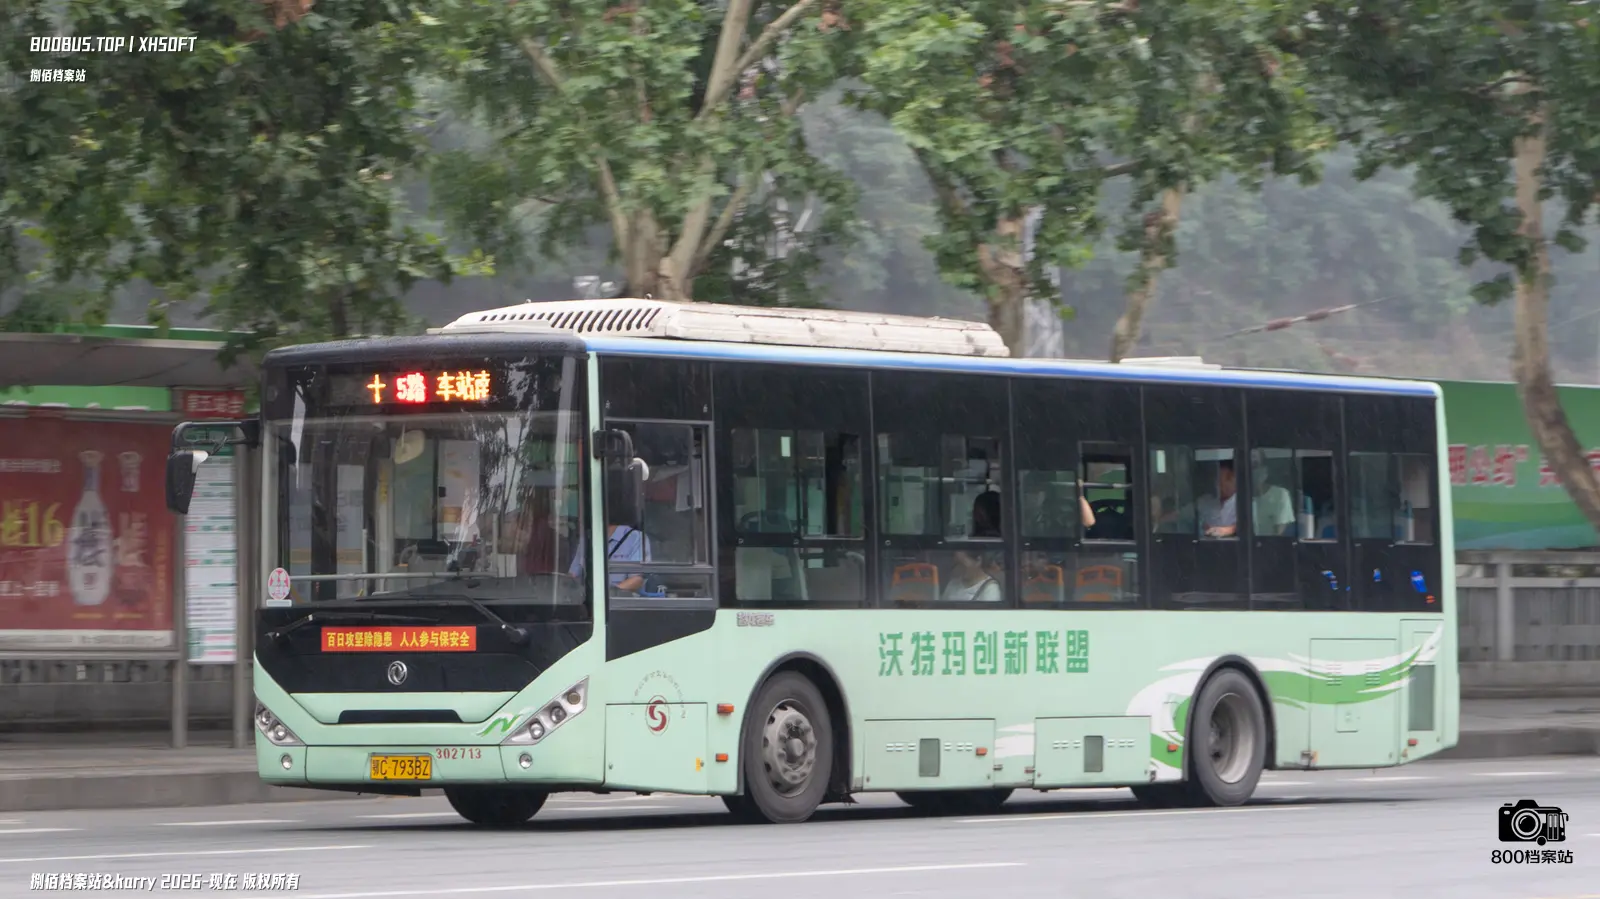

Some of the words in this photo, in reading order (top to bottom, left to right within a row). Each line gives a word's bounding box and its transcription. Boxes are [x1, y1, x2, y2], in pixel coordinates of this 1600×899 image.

[396, 372, 426, 402] 5路
[436, 370, 491, 401] 车站南
[326, 631, 393, 648] 百日攻坚除隐患
[400, 631, 470, 648] 人人参与保安全
[878, 630, 1089, 677] 沃特玛创新联盟
[435, 747, 482, 760] 302713
